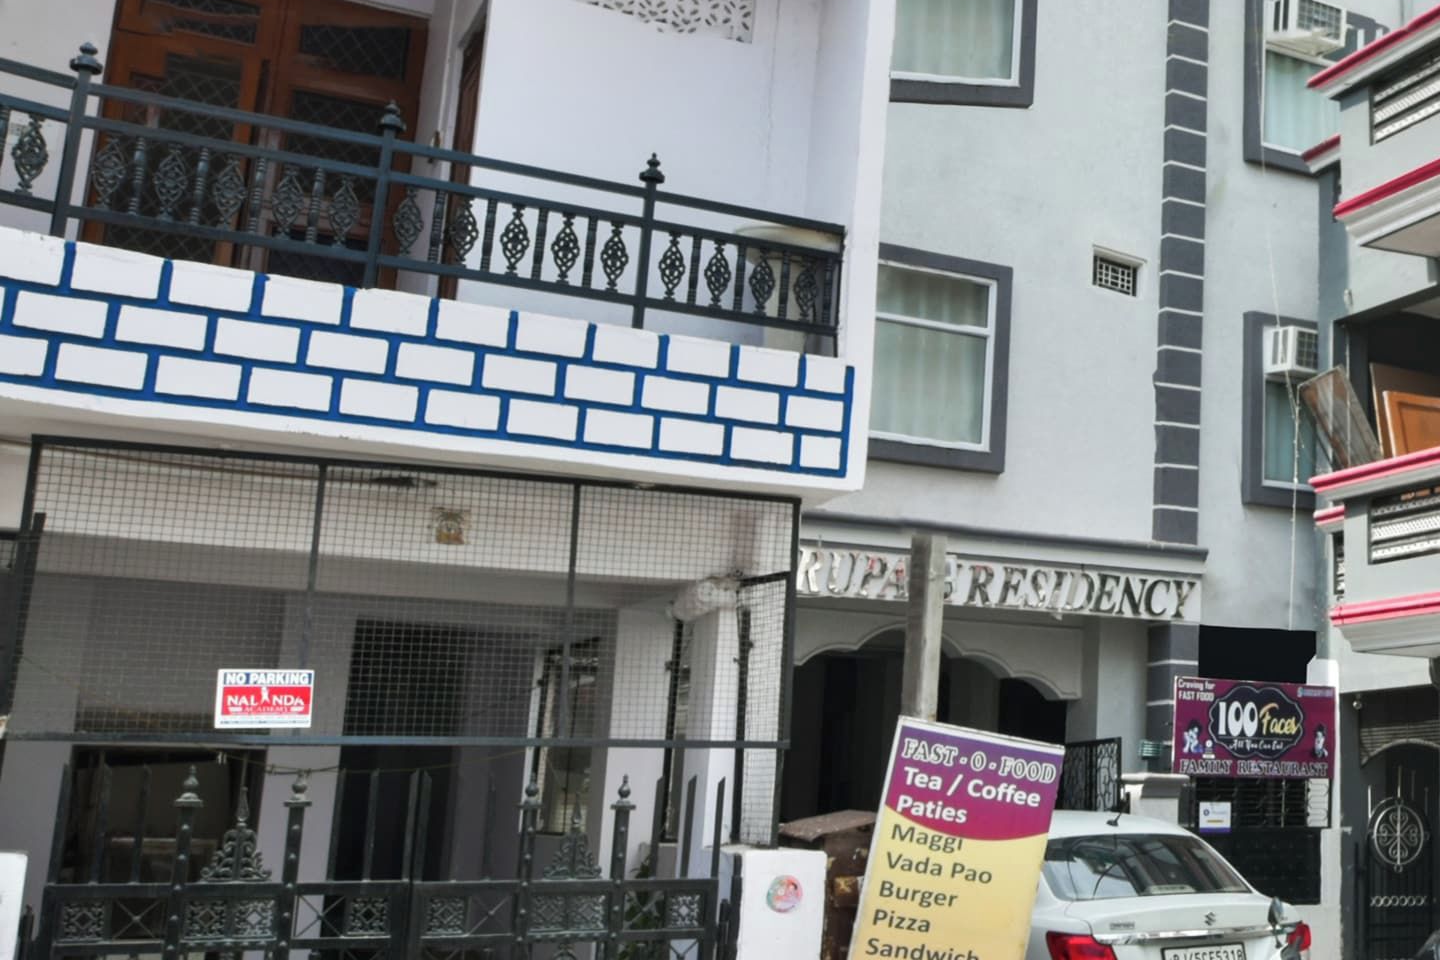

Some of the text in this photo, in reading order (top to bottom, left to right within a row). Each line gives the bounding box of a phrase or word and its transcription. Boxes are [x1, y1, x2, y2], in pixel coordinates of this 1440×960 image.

[967, 564, 1197, 620] RESIDENCY
[226, 672, 309, 685] NO PARKING
[1178, 690, 1215, 702] FAST FOOD
[1217, 701, 1300, 737] 100 Faces
[902, 738, 958, 766] FAST
[999, 755, 1057, 784] FOOD
[1179, 759, 1328, 777] FAMILY RESTAURANT
[904, 766, 1041, 807] Tea / Coffee
[896, 795, 968, 823] Paties
[891, 823, 963, 854] Maggi
[886, 851, 992, 885] Vada Pao
[879, 880, 958, 908] Burger
[872, 908, 931, 933] Pizza
[865, 937, 980, 960] Sandwich
